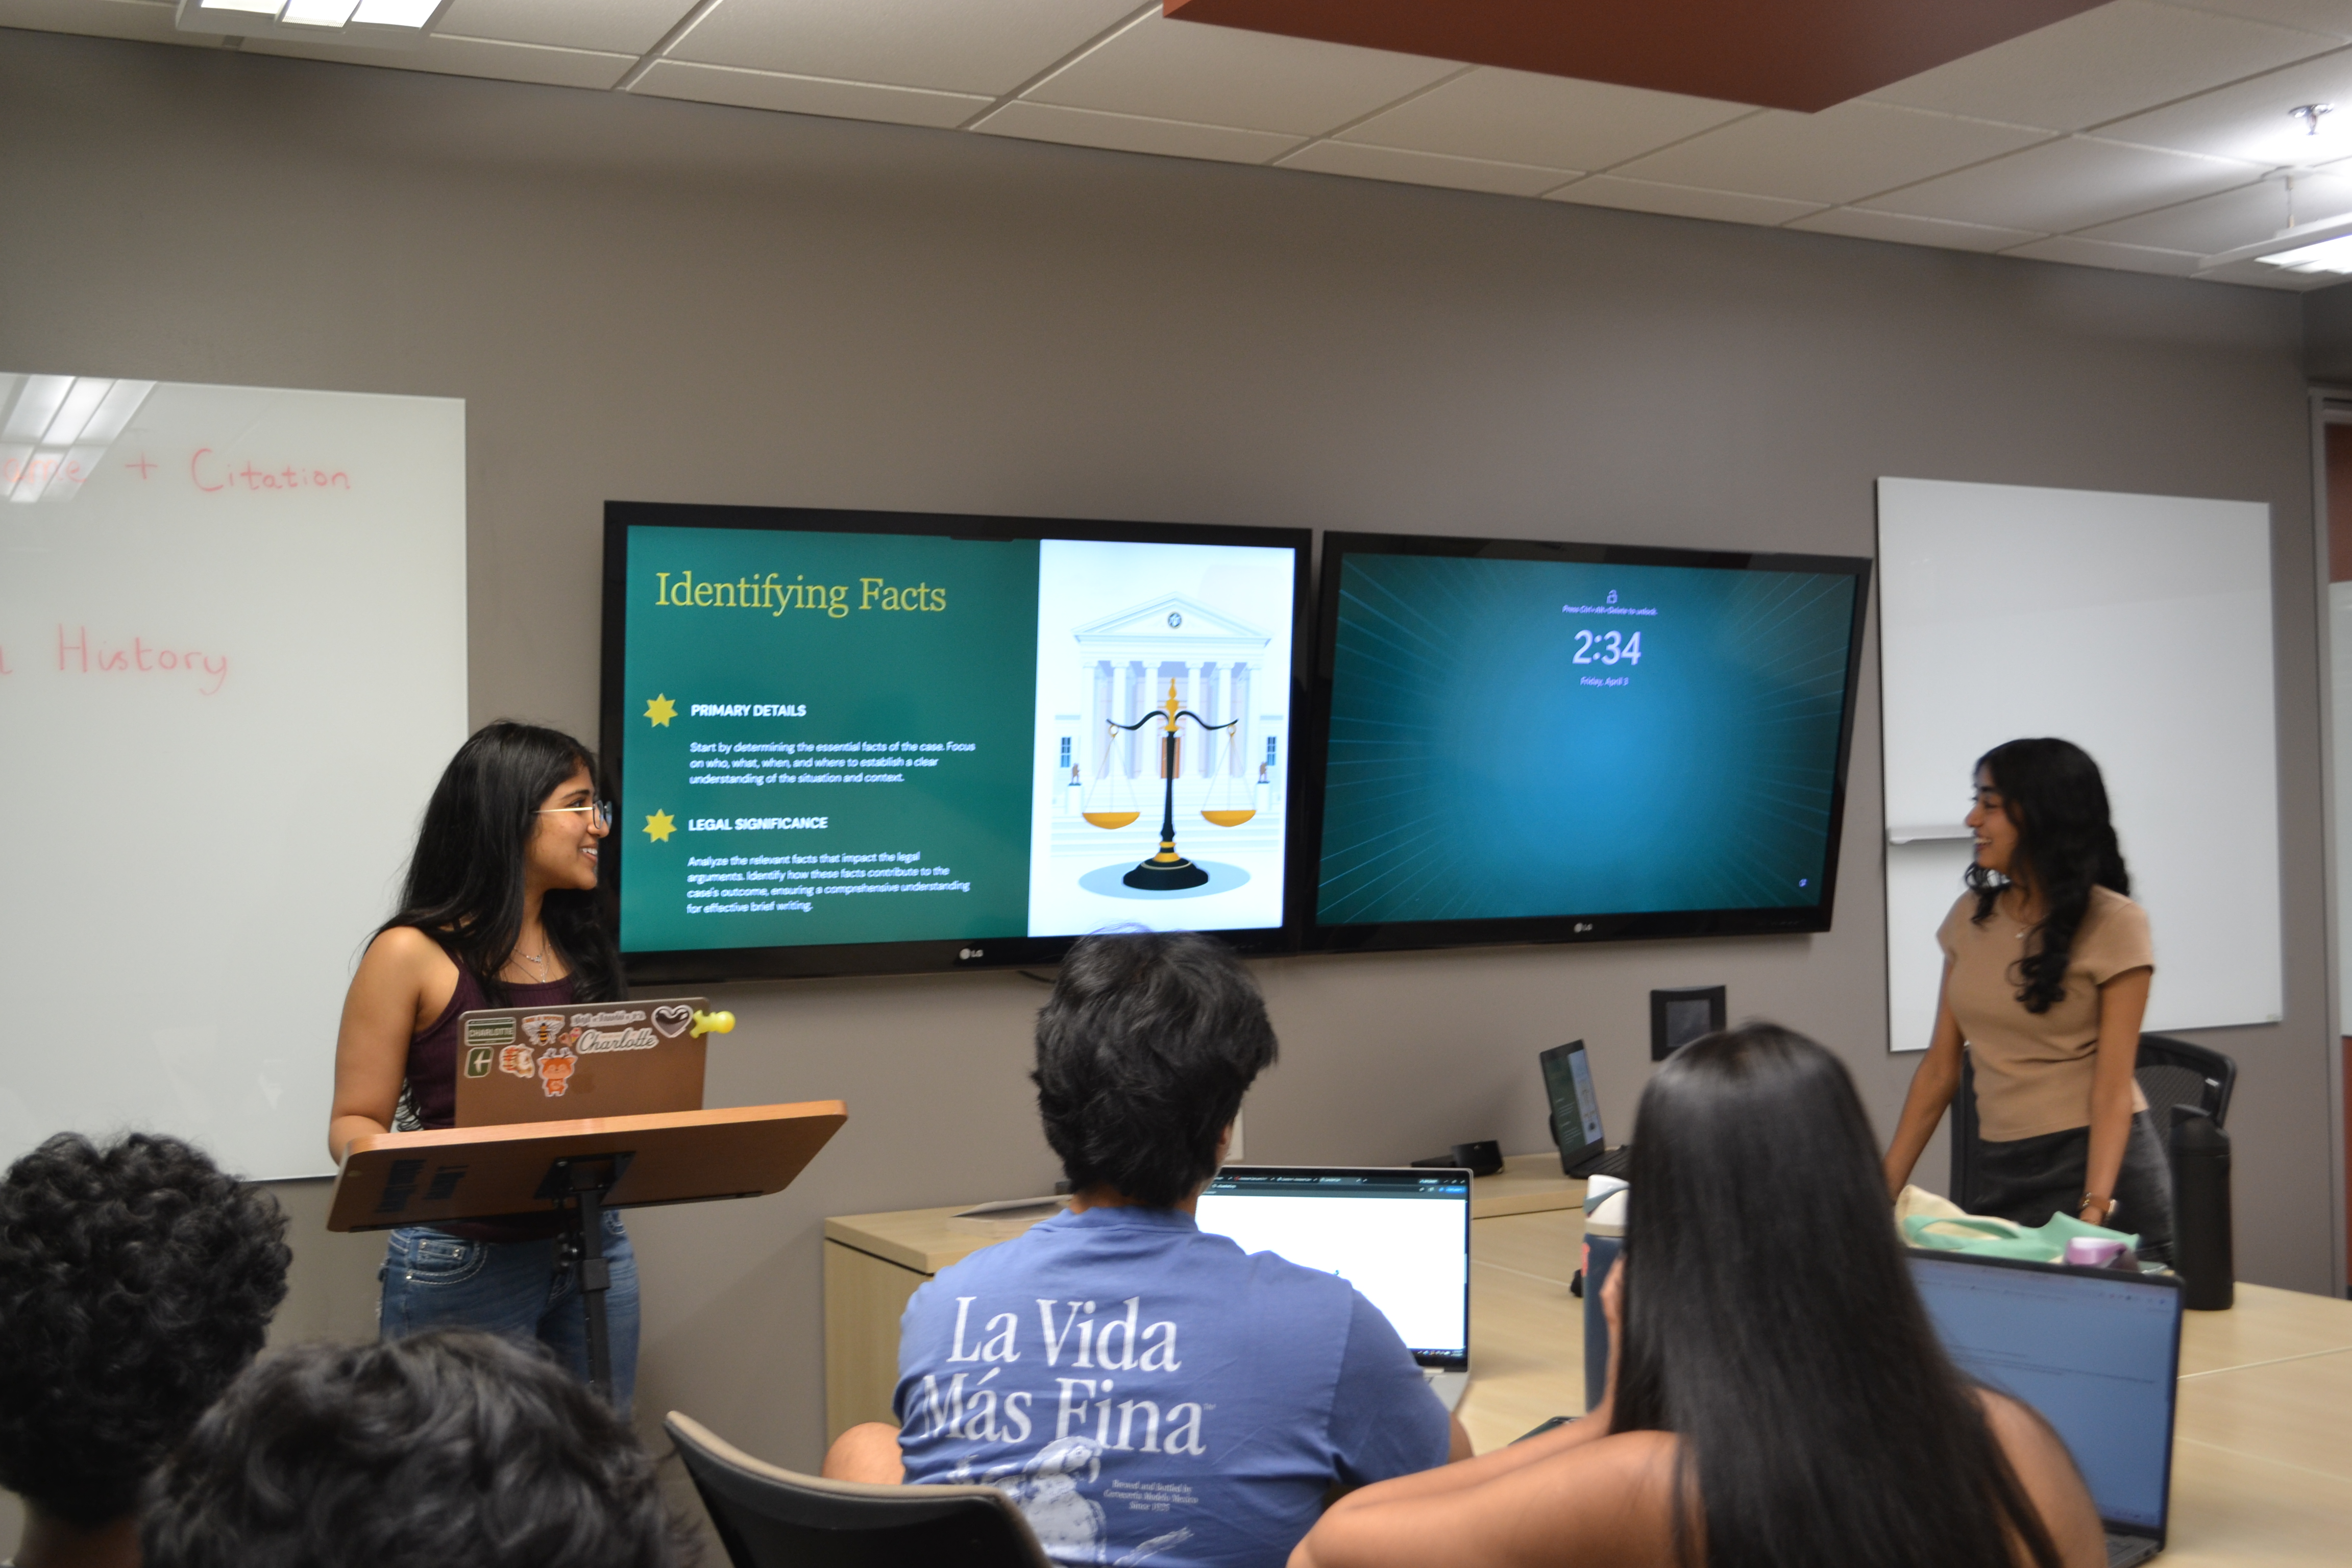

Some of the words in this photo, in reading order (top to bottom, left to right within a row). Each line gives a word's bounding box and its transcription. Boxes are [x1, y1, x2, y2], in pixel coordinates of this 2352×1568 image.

[191, 447, 351, 492] Citation
[655, 571, 849, 618] Identifying
[859, 577, 947, 612] Facts
[1572, 629, 1642, 666] 2:34
[57, 623, 228, 696] History
[1580, 676, 1604, 687] Friday,
[1604, 677, 1623, 688] April
[691, 704, 751, 718] PRIMARY
[753, 704, 807, 717] DETAILS
[690, 742, 717, 753] Start
[718, 742, 732, 754] by
[733, 742, 795, 754] determining
[797, 742, 815, 752] the
[816, 742, 861, 752] essential
[862, 741, 888, 751] facts
[888, 741, 900, 751] of
[901, 741, 918, 751] the
[919, 743, 945, 751] case.
[946, 741, 976, 751] Focus
[689, 759, 704, 768] on
[705, 757, 730, 769] who,
[731, 757, 760, 769] what,
[761, 757, 791, 769] when,
[793, 757, 813, 768] and
[814, 757, 846, 768] where
[847, 757, 859, 767] to
[860, 756, 904, 767] establish
[905, 758, 912, 767] a
[914, 756, 939, 767] clear
[689, 773, 764, 786] understanding
[766, 773, 777, 783] of
[778, 773, 796, 783] the
[797, 772, 842, 783] situation
[843, 772, 863, 783] and
[864, 773, 905, 782] context.
[688, 818, 732, 831] LEGAL
[734, 817, 829, 830] SIGNIFICANCE
[687, 856, 729, 868] Analyze
[730, 855, 748, 866] the
[749, 854, 791, 865] relevant
[792, 853, 818, 864] facts
[819, 853, 840, 864] that
[841, 853, 877, 865] impact
[878, 852, 896, 862] the
[897, 851, 921, 864] legal
[687, 872, 745, 885] arguments.
[746, 870, 786, 882] Identify
[787, 869, 810, 879] how
[811, 869, 839, 878] these
[840, 868, 866, 878] facts
[867, 867, 919, 877] contribute
[920, 867, 932, 876] to
[933, 866, 950, 876] the
[687, 887, 719, 898] case's
[720, 887, 769, 897] outcome,
[770, 885, 814, 897] ensuring
[815, 886, 823, 894] a
[824, 882, 899, 896] comprehensive
[900, 880, 971, 892] understanding
[687, 903, 702, 914] for
[703, 902, 749, 913] effective
[750, 901, 775, 912] brief
[776, 900, 814, 913] writing.
[469, 1027, 513, 1037] CHARLOTTE
[579, 1030, 656, 1052] Charlotte
[946, 1296, 1020, 1363] La
[1036, 1296, 1182, 1372] Vida
[920, 1367, 1033, 1443] Más
[1055, 1378, 1207, 1455] Fina
[1141, 1482, 1155, 1490] and
[1129, 1501, 1150, 1510] Since
